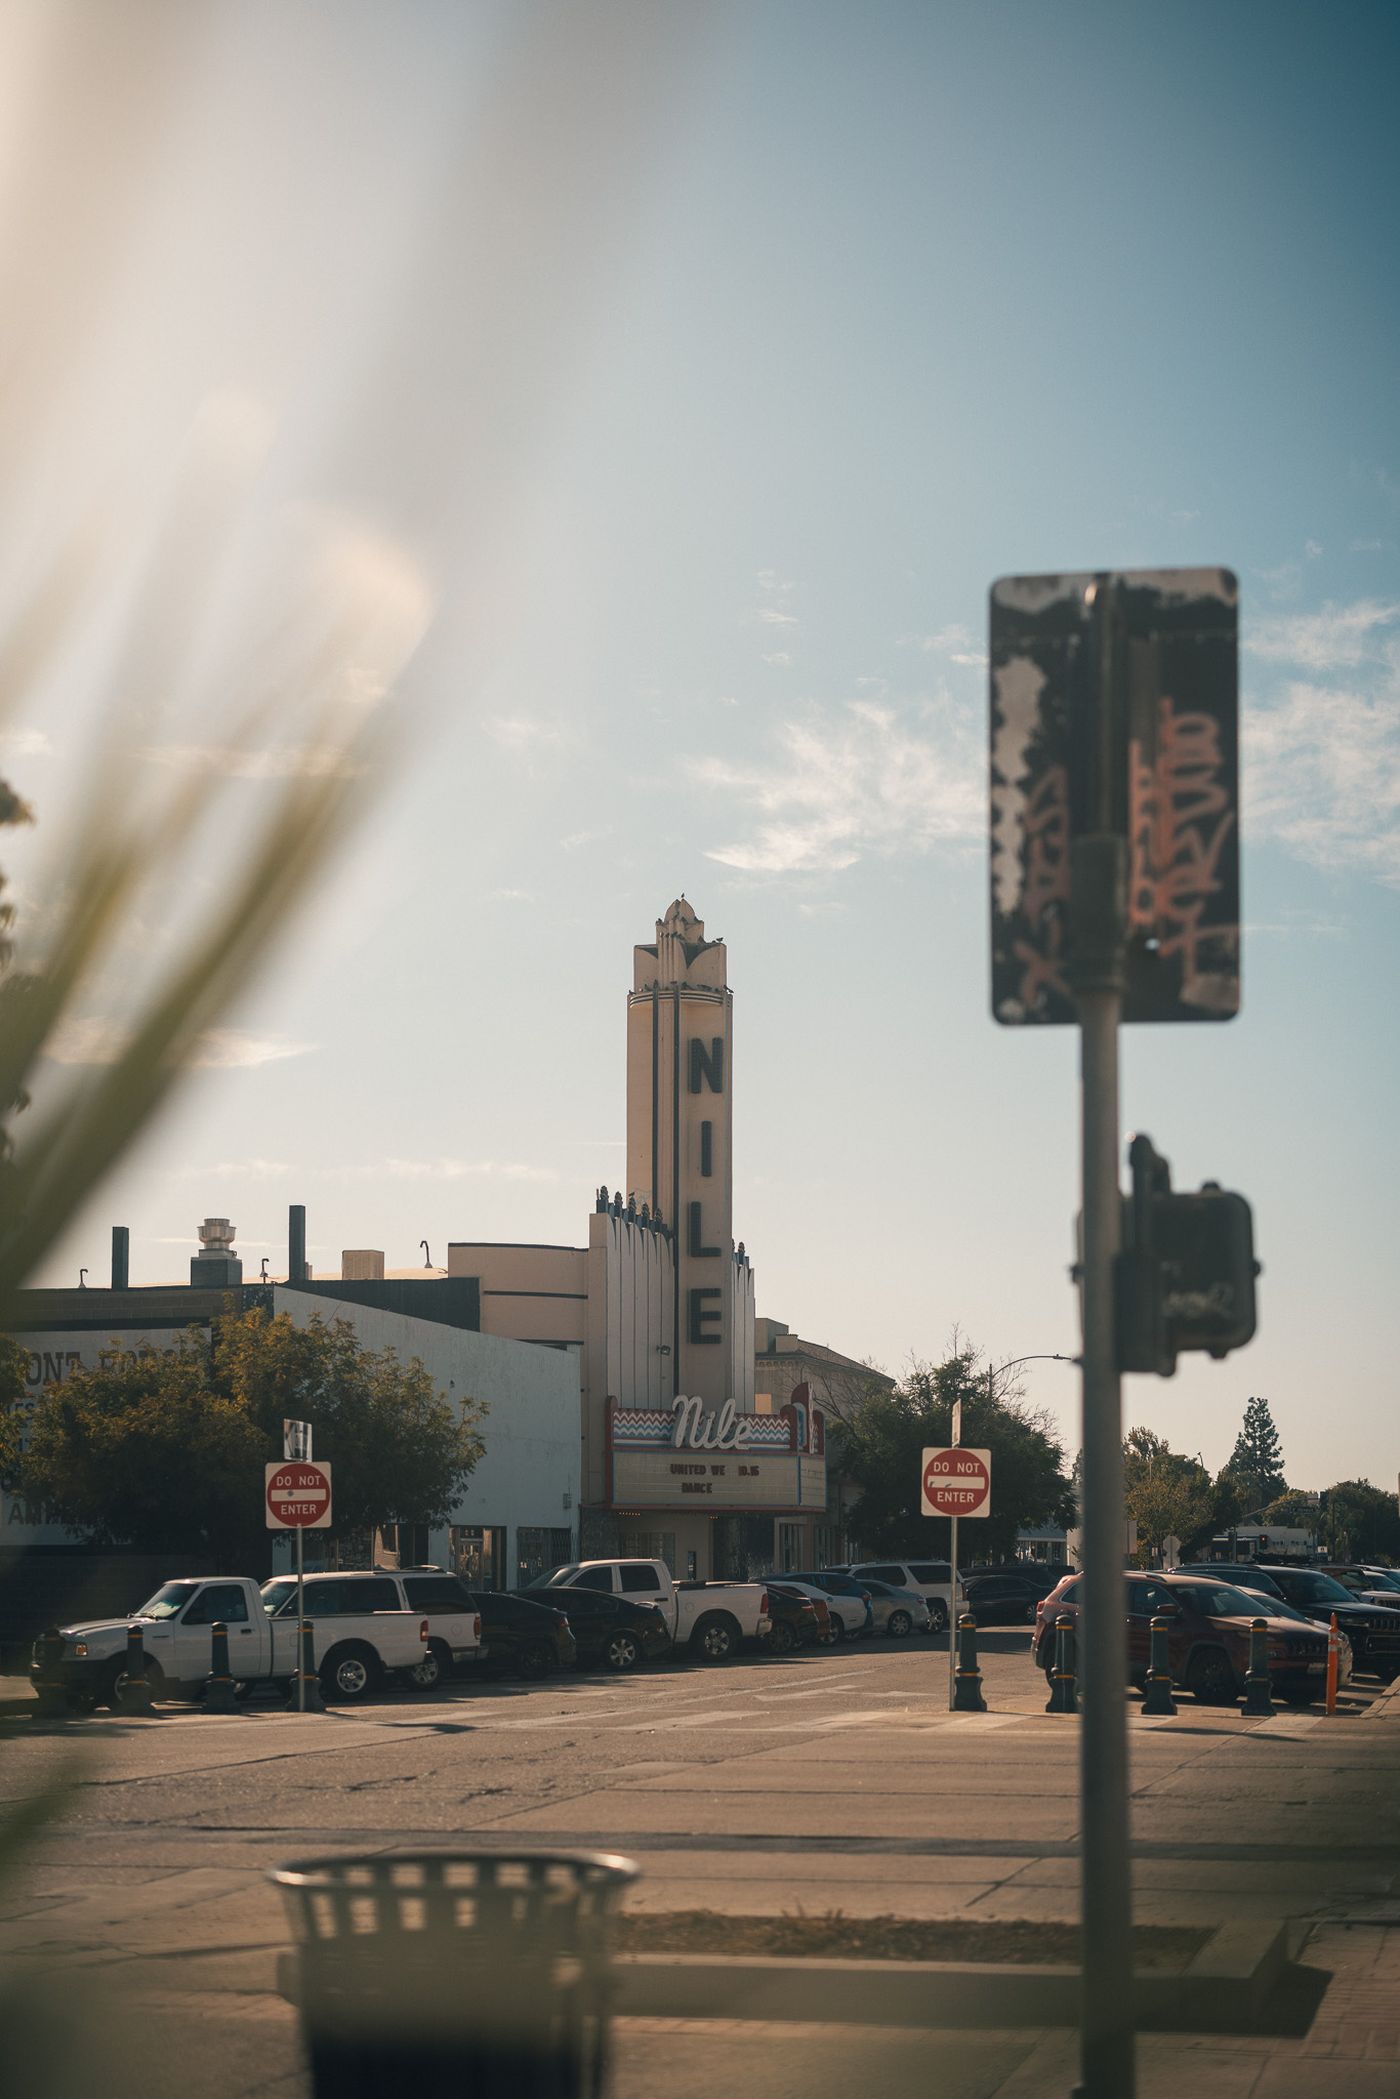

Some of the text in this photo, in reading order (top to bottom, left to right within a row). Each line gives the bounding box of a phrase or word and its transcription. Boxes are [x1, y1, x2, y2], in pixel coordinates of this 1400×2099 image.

[687, 1037, 723, 1344] NILE
[672, 1394, 751, 1449] Nile
[670, 1463, 707, 1476] UNITED
[710, 1465, 726, 1476] WE
[933, 1462, 980, 1473] DO NOT
[276, 1475, 320, 1486] DO NOT
[681, 1482, 713, 1494] DANCE
[937, 1491, 975, 1503] ENTER
[281, 1504, 317, 1515] ENTER
